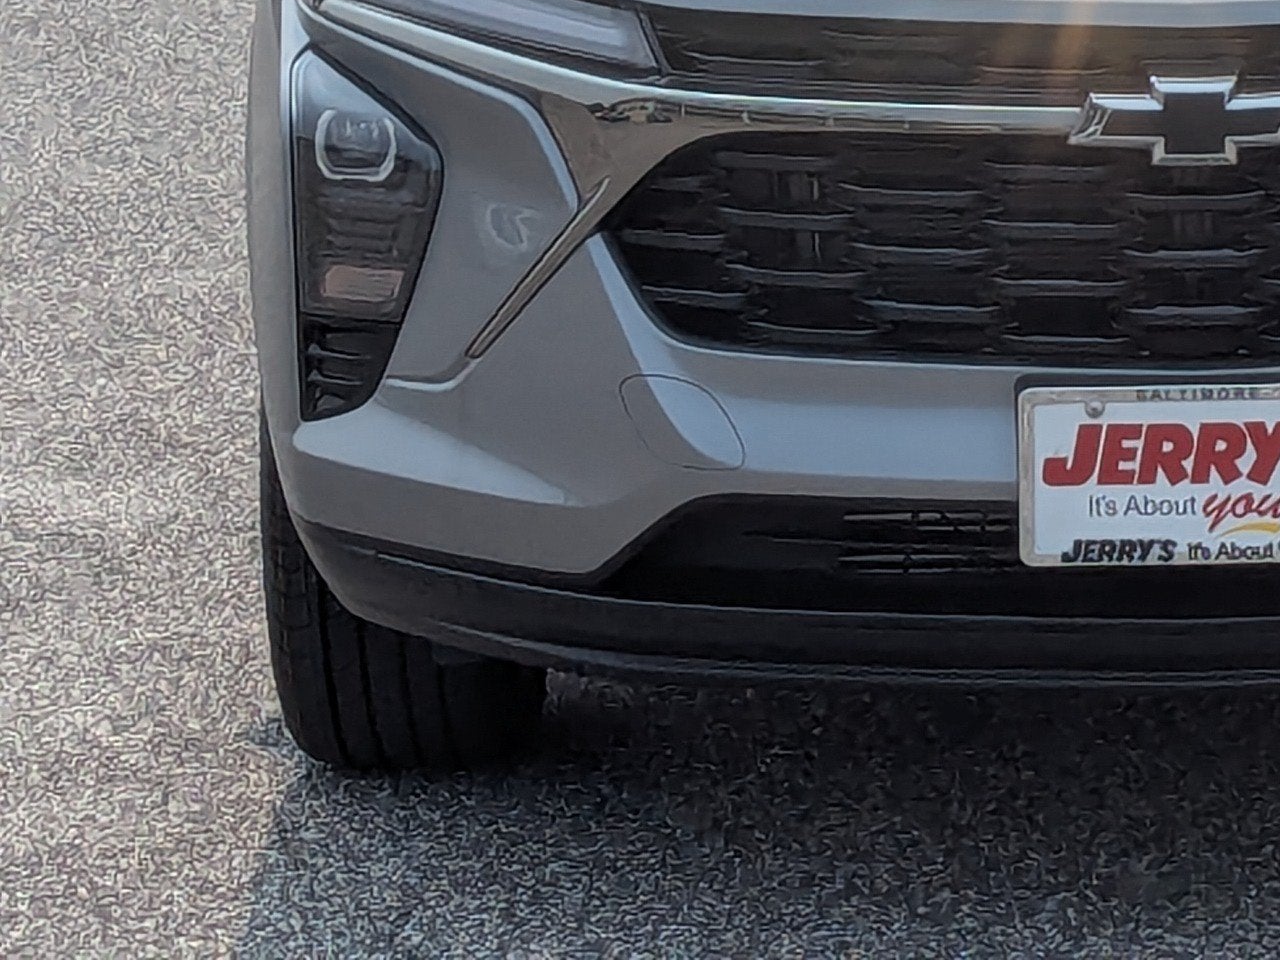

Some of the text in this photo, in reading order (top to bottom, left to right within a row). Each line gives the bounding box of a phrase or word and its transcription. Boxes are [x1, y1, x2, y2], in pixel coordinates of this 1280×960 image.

[1088, 494, 1118, 517] It's
[1123, 493, 1197, 517] About
[1061, 538, 1178, 563] JERRY'S
[1215, 541, 1273, 560] About
